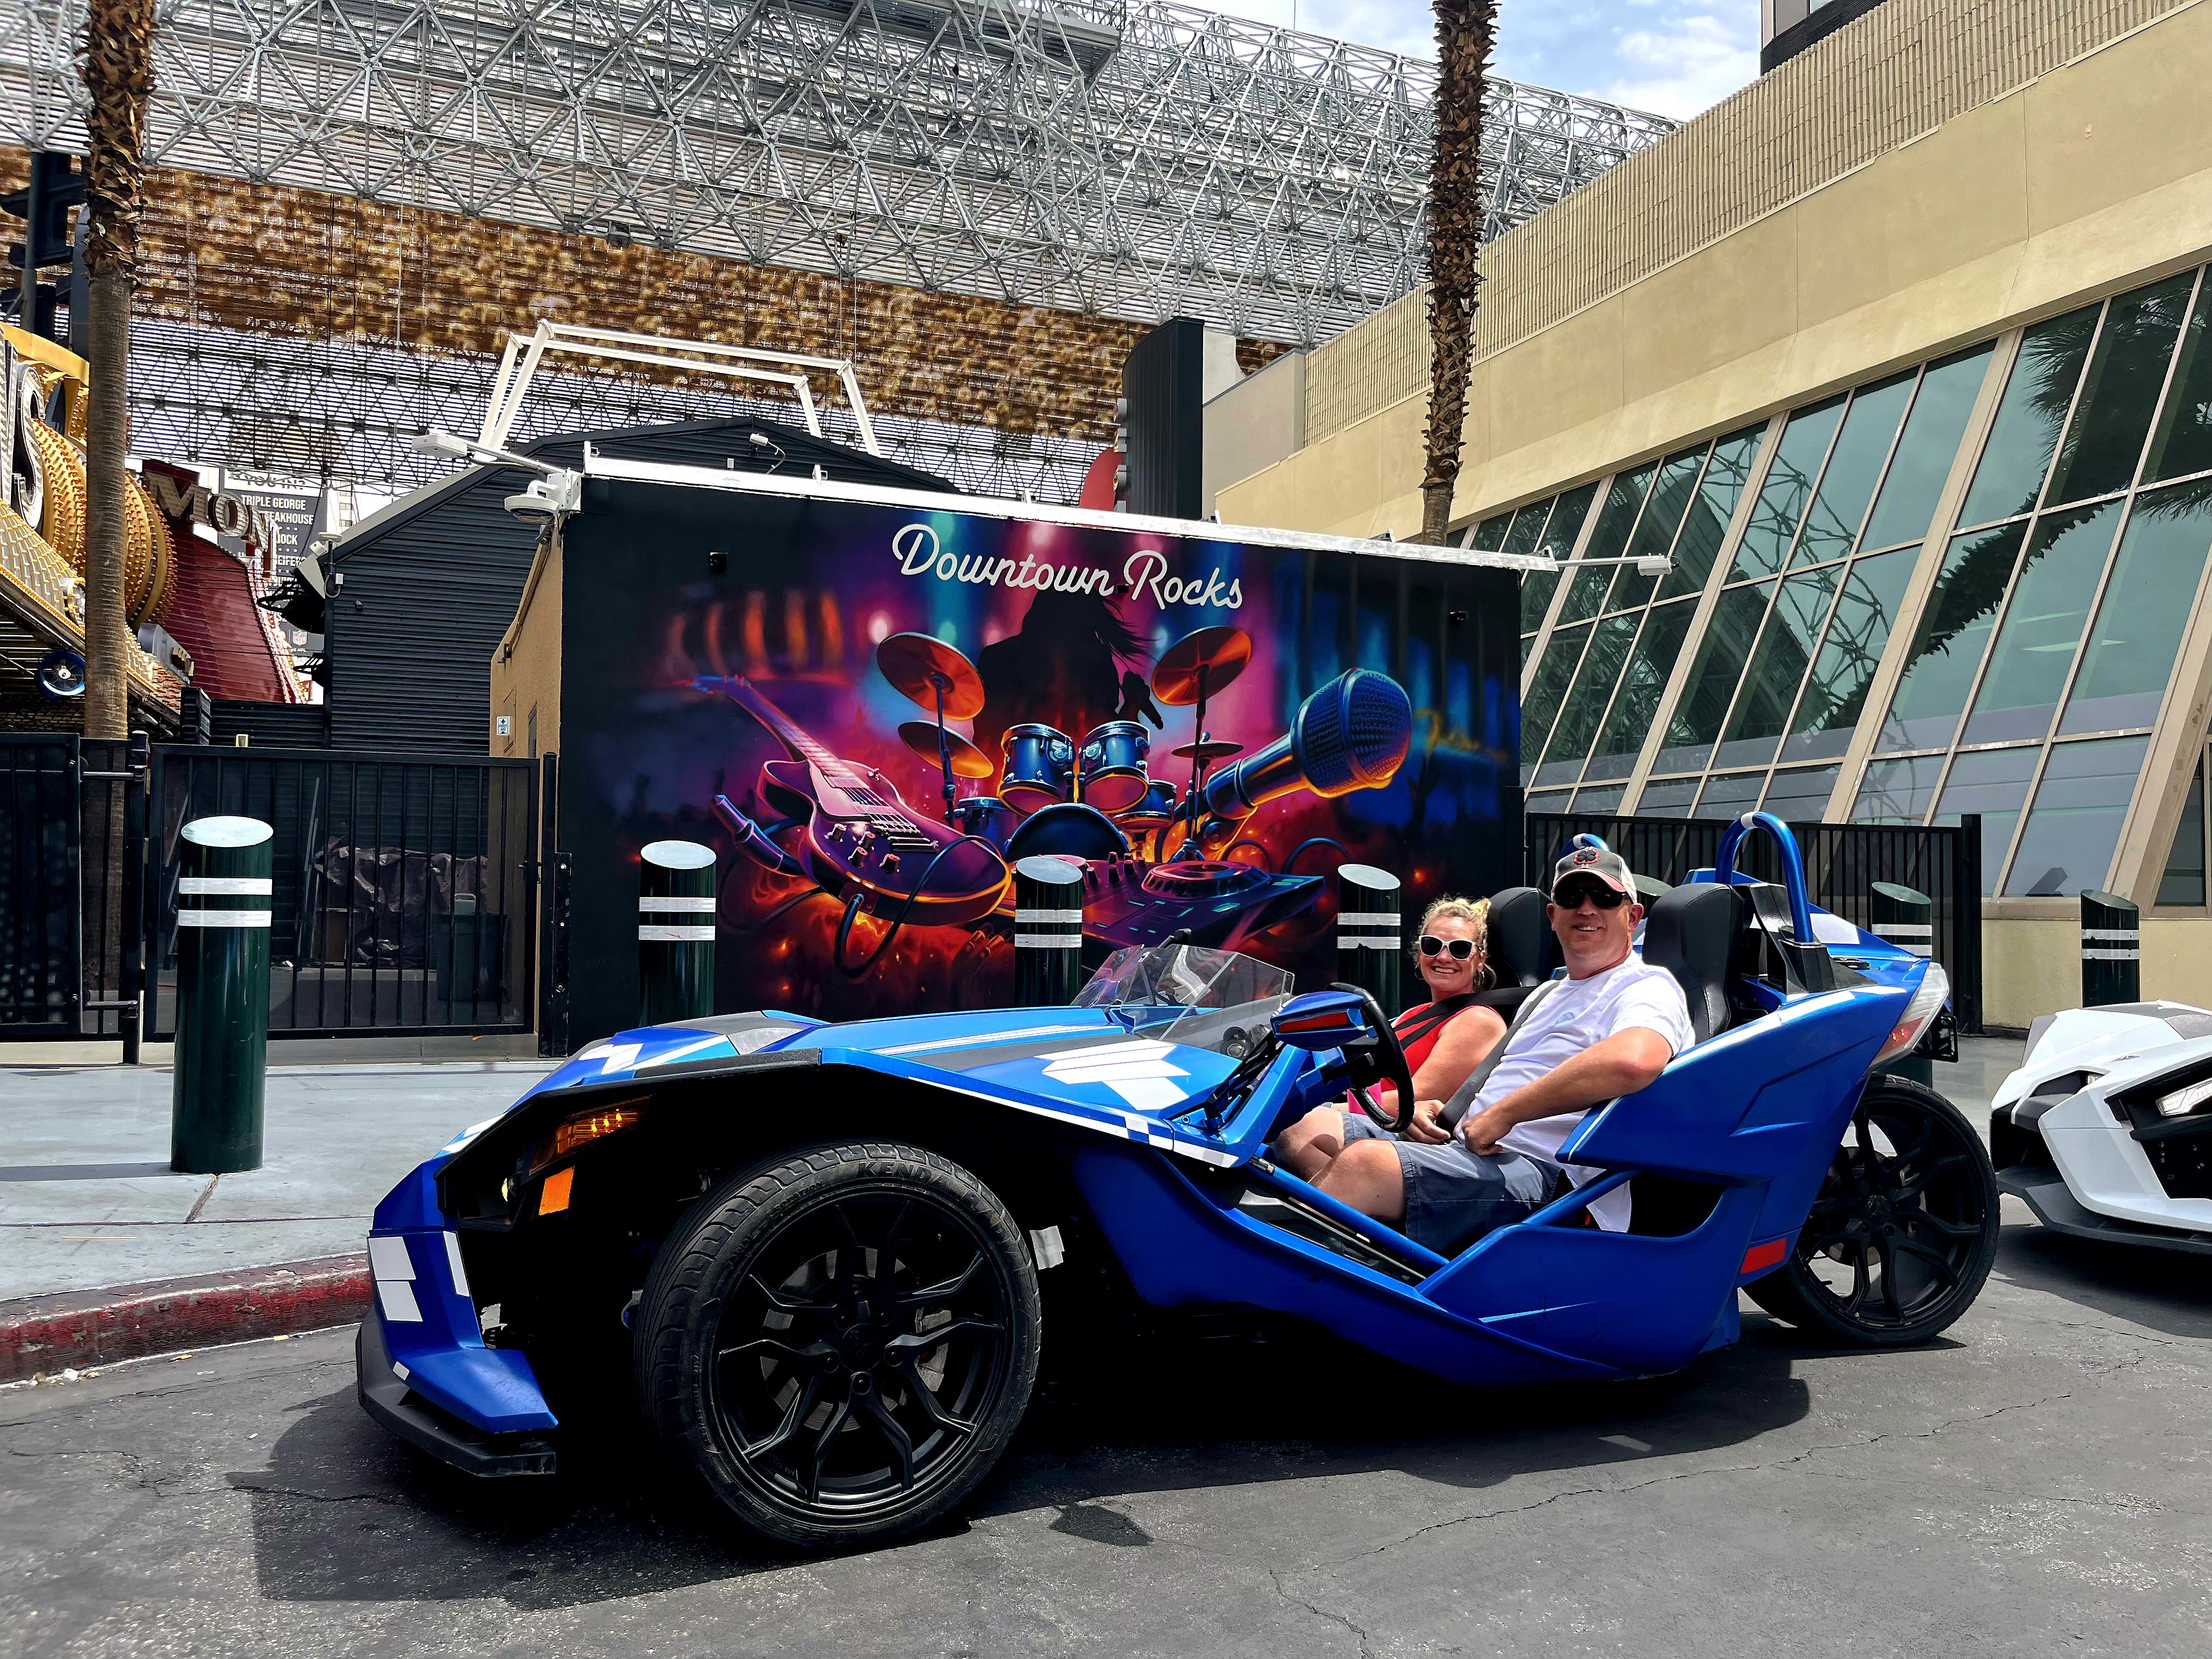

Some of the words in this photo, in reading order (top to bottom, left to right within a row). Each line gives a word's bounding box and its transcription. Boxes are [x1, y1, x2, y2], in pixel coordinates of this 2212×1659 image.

[241, 495, 271, 507] TRIPLE
[273, 498, 307, 511] GEORGE
[891, 523, 1117, 597] Downtown
[1123, 550, 1243, 610] Rocks
[856, 1161, 953, 1189] KENDA
